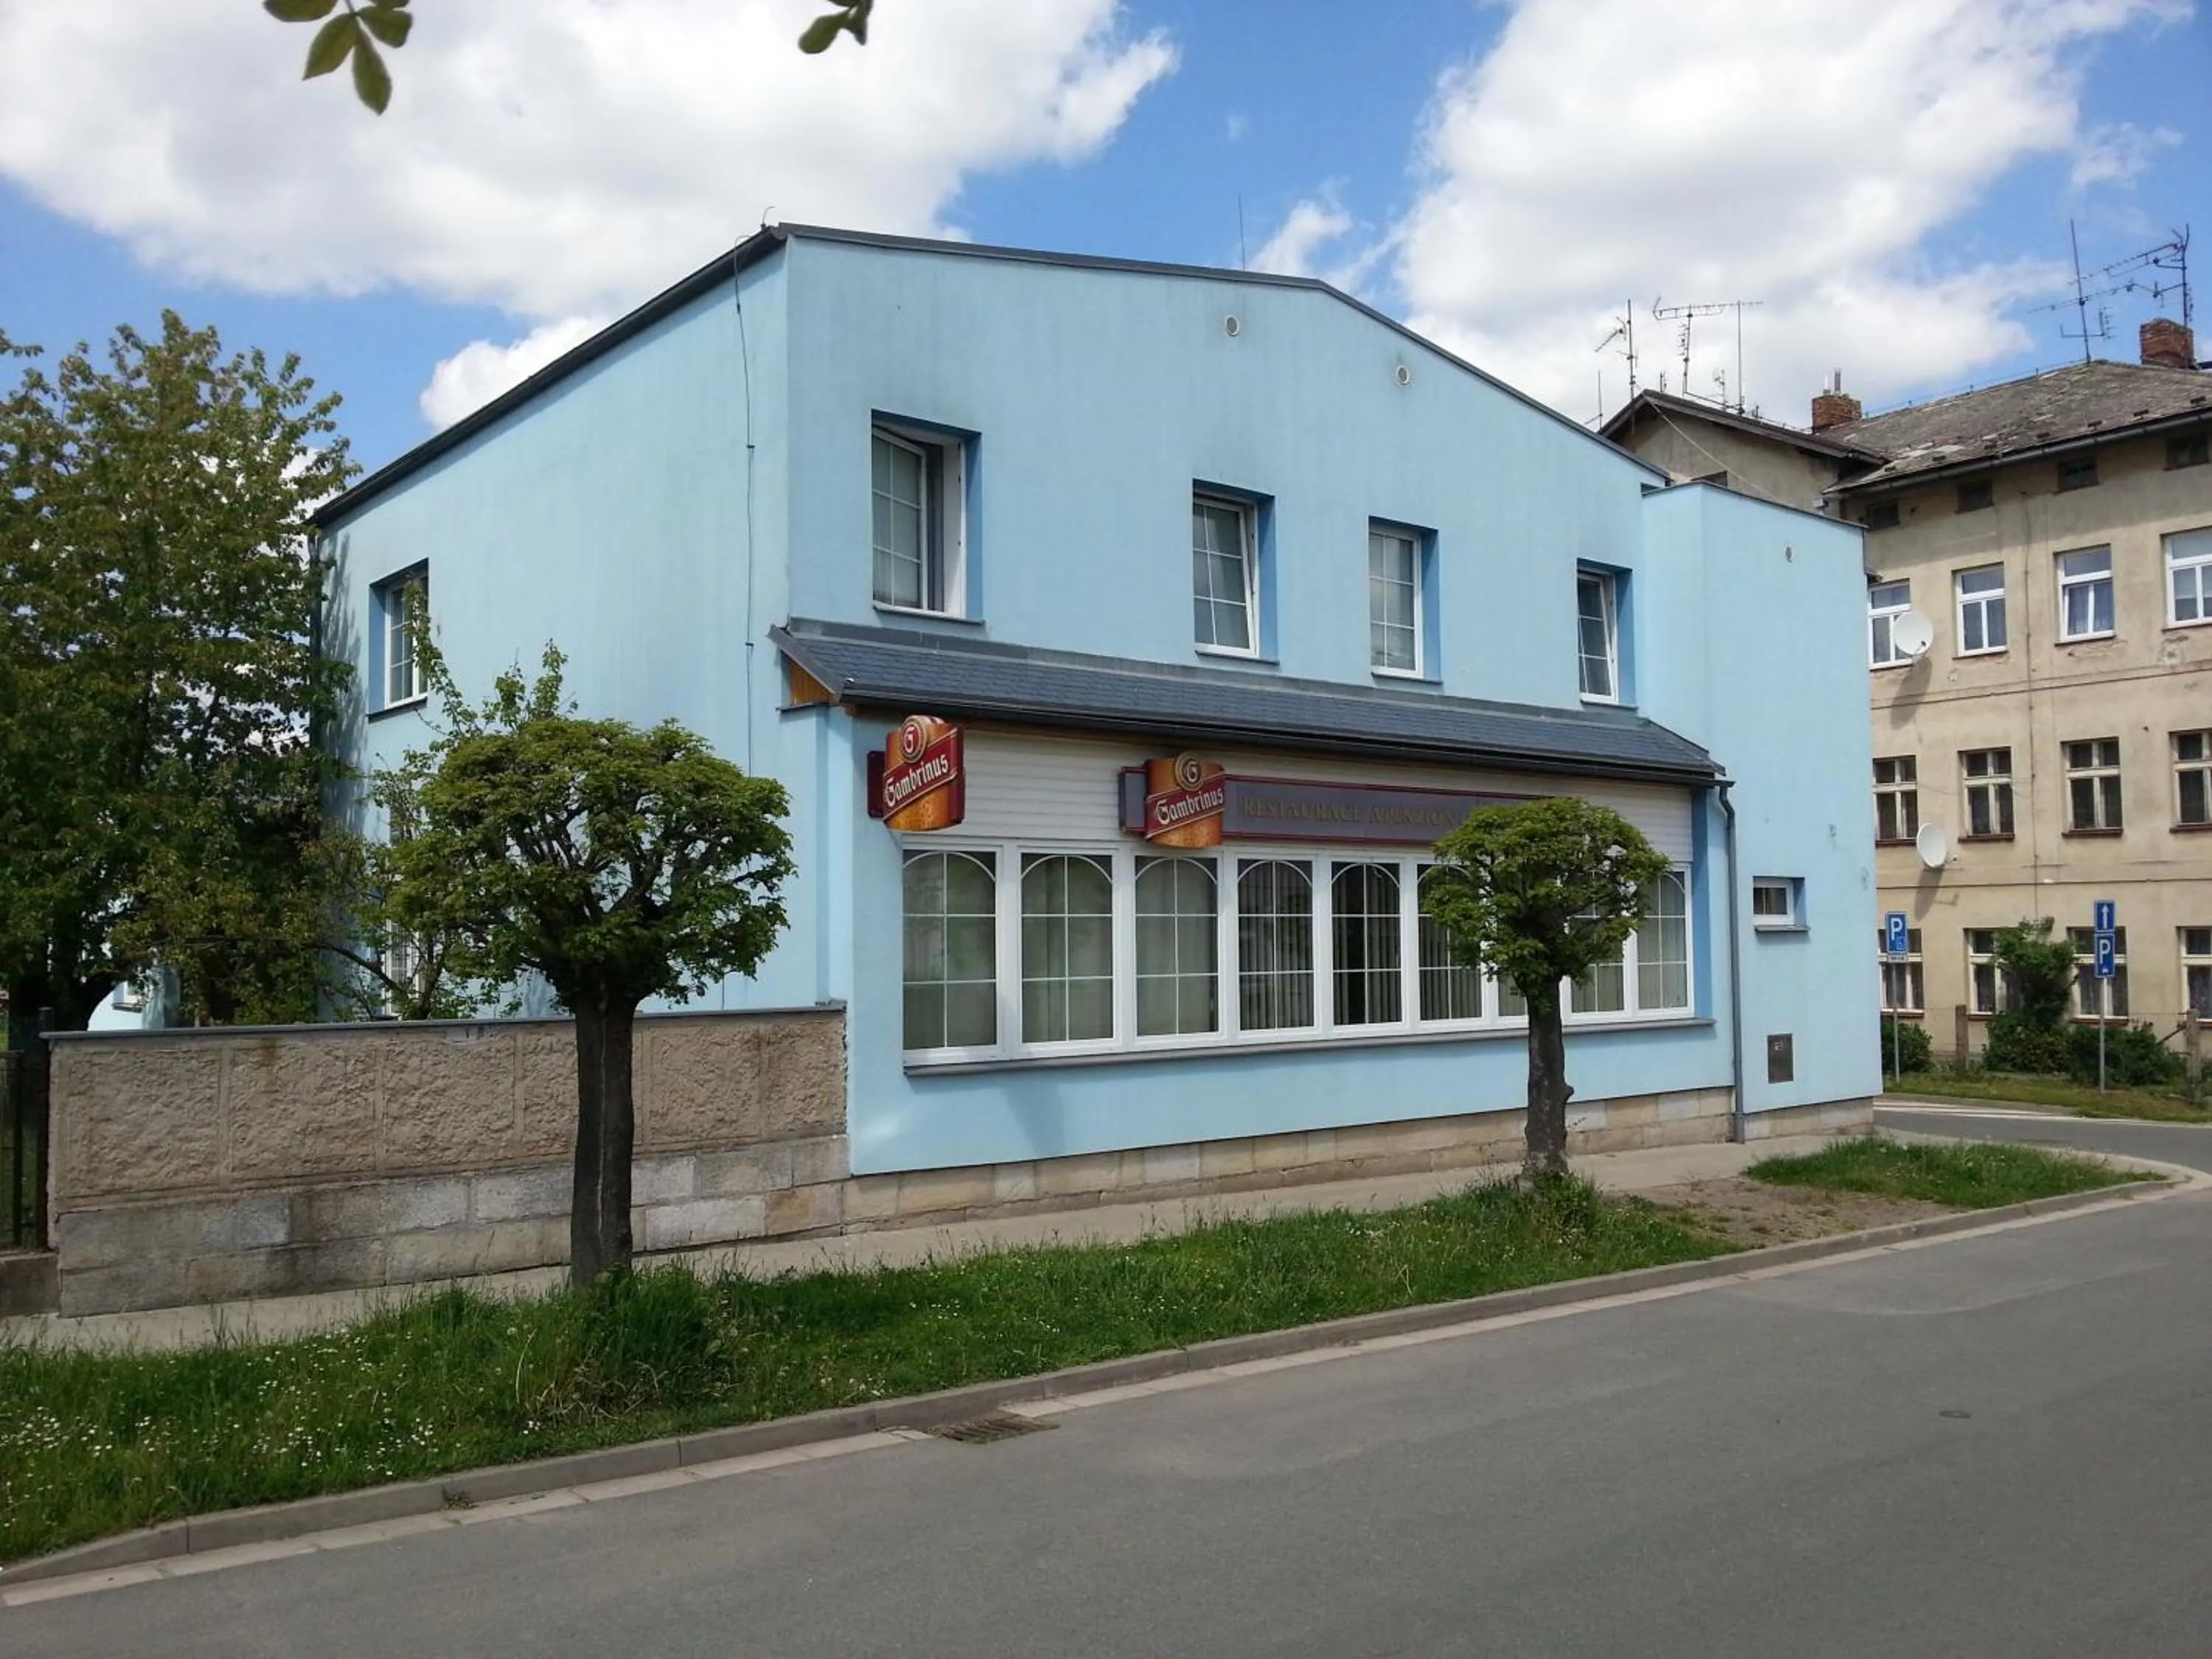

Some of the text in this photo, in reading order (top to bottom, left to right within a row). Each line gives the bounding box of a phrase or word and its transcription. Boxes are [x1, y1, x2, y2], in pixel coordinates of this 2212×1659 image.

[885, 754, 949, 807] Gambrinus
[1156, 788, 1223, 824] Gambrinus
[1243, 796, 1361, 821] RESTAURACE
[1891, 918, 1903, 941] P
[2099, 939, 2111, 964] P
